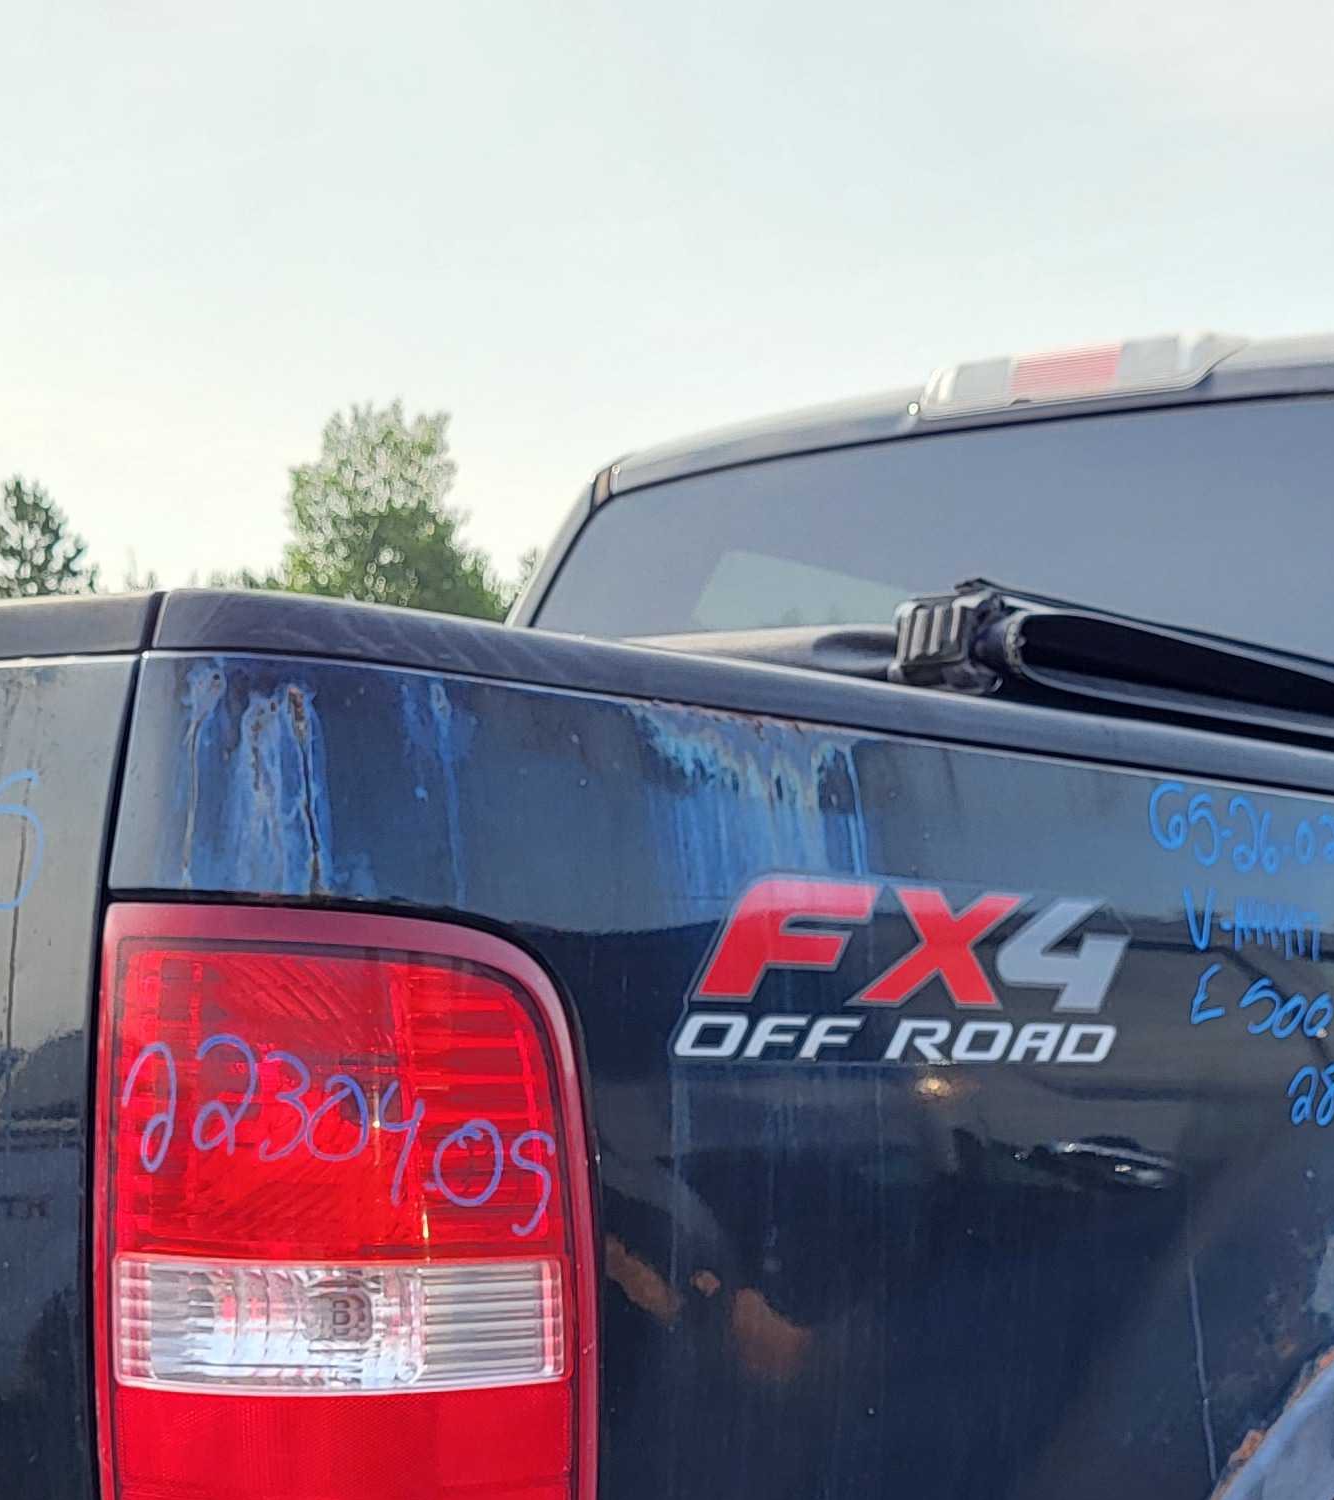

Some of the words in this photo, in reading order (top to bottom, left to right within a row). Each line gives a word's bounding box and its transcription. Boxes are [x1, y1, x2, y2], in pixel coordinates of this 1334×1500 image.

[689, 869, 1135, 1013] FX4
[672, 1012, 864, 1061] OFF
[882, 1017, 1117, 1064] ROAD
